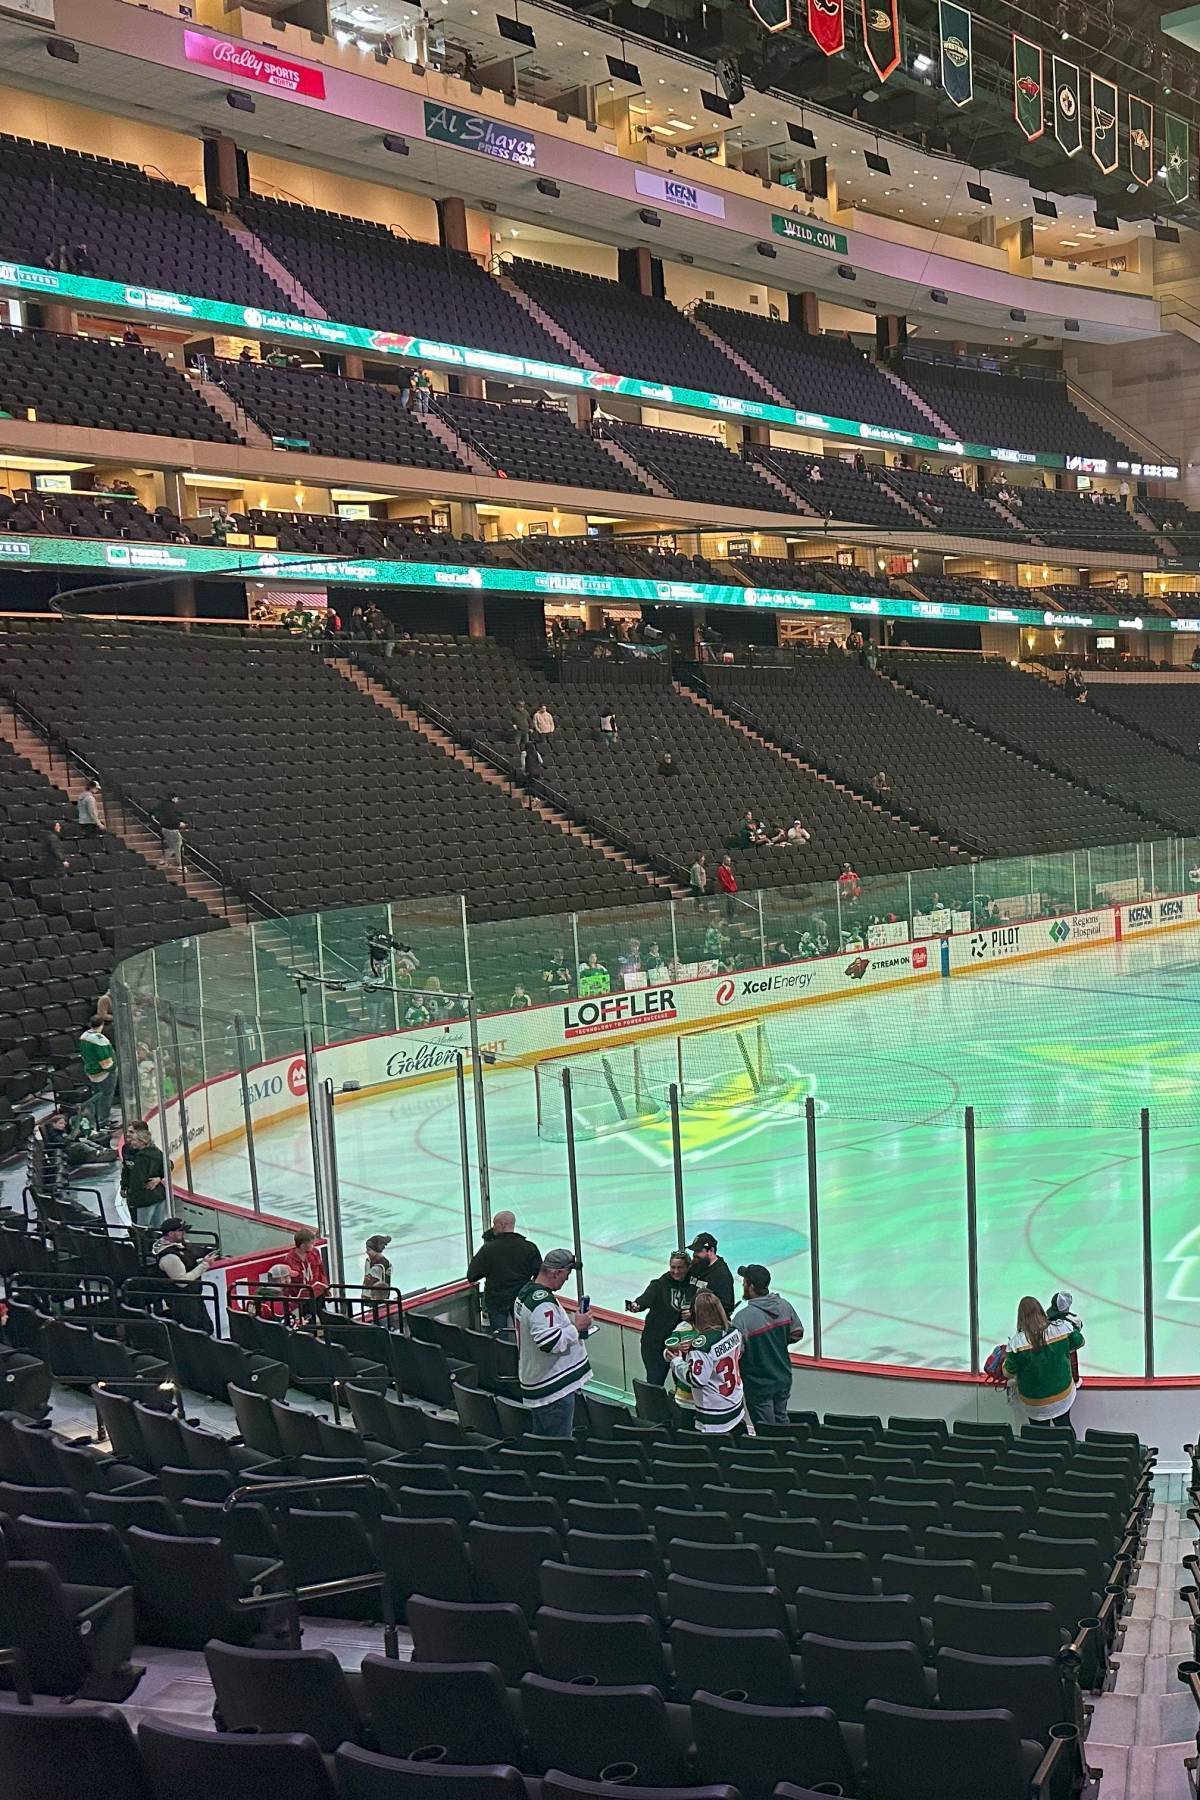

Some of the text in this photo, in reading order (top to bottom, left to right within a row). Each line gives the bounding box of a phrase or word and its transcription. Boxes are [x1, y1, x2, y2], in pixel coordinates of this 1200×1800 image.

[213, 42, 300, 82] Bally SPORTS
[272, 77, 295, 89] NORTH
[427, 108, 536, 155] Al Shaver
[478, 142, 536, 167] PRESS BOX
[665, 181, 697, 203] KFAN
[783, 218, 837, 250] WILD.COM
[1128, 905, 1152, 922] KFAN
[1160, 900, 1183, 917] KFAN
[1072, 915, 1099, 928] Regions
[1073, 924, 1101, 939] Hospital
[991, 927, 1020, 948] PILOT
[871, 956, 910, 970] STREAM ON
[741, 972, 813, 996] Xcel Energy
[563, 989, 677, 1029] LOFFLER
[386, 1044, 460, 1077] Golden
[543, 1310, 554, 1328] 7
